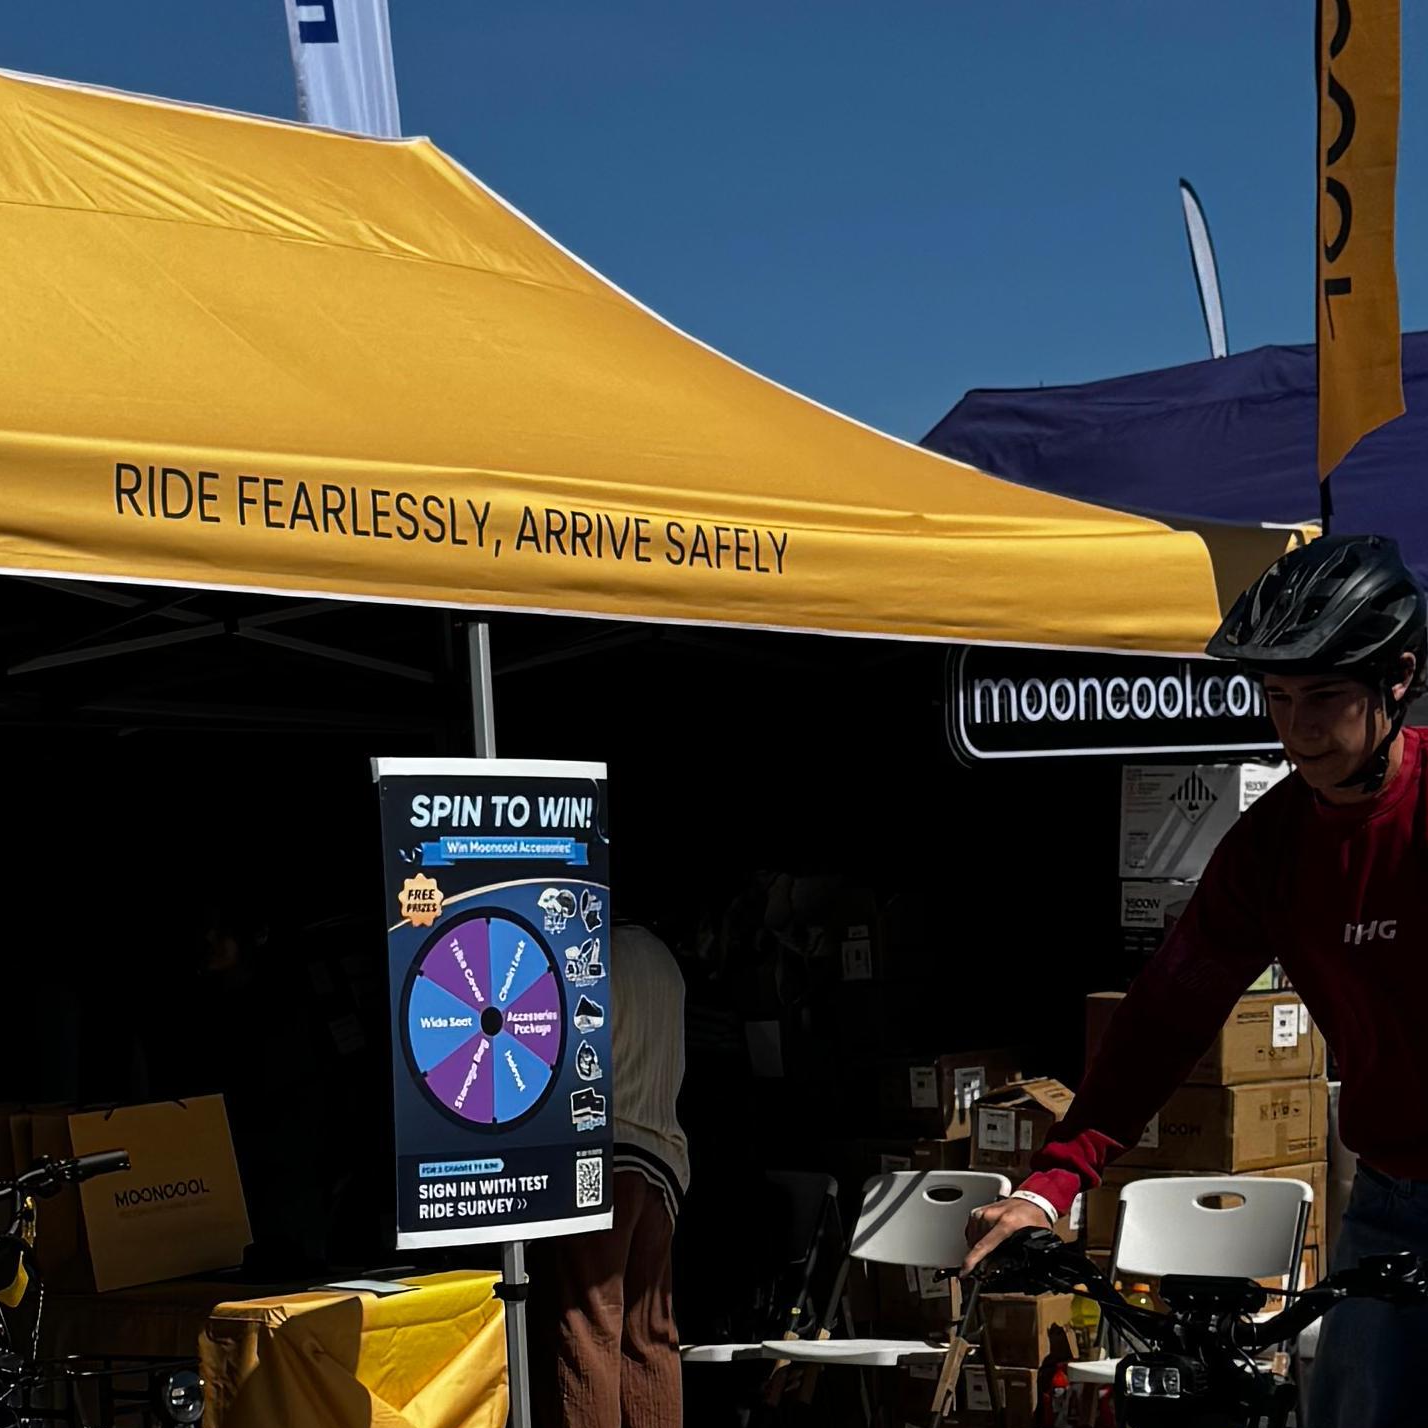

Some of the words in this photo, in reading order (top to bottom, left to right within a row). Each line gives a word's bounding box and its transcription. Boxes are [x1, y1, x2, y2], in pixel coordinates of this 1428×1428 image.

[113, 462, 220, 524] RIDE
[236, 474, 503, 558] FEARLESSLY,
[515, 505, 652, 563] ARRIVE
[664, 520, 789, 575] SAFELY
[410, 794, 483, 829] SPIN
[491, 795, 530, 829] TO
[537, 797, 593, 830] WIN!
[407, 889, 435, 900] FREE
[406, 903, 437, 913] PRIZES
[449, 937, 467, 969] Trike
[465, 967, 485, 1002] Cover
[498, 971, 515, 1002] Chain
[512, 939, 526, 969] Lock
[420, 1016, 447, 1028] Wide
[449, 1016, 472, 1027] Seat
[506, 1009, 558, 1023] Accessories
[513, 1023, 552, 1037] Package
[454, 1061, 480, 1110] Storage
[114, 1177, 210, 1208] MOONCOOL
[418, 1182, 457, 1200] SIGN
[460, 1181, 476, 1197] IN
[479, 1178, 517, 1195] WITH
[518, 1174, 549, 1192] TEST
[419, 1203, 454, 1219] RIDE
[457, 1198, 514, 1217] SURVEY
